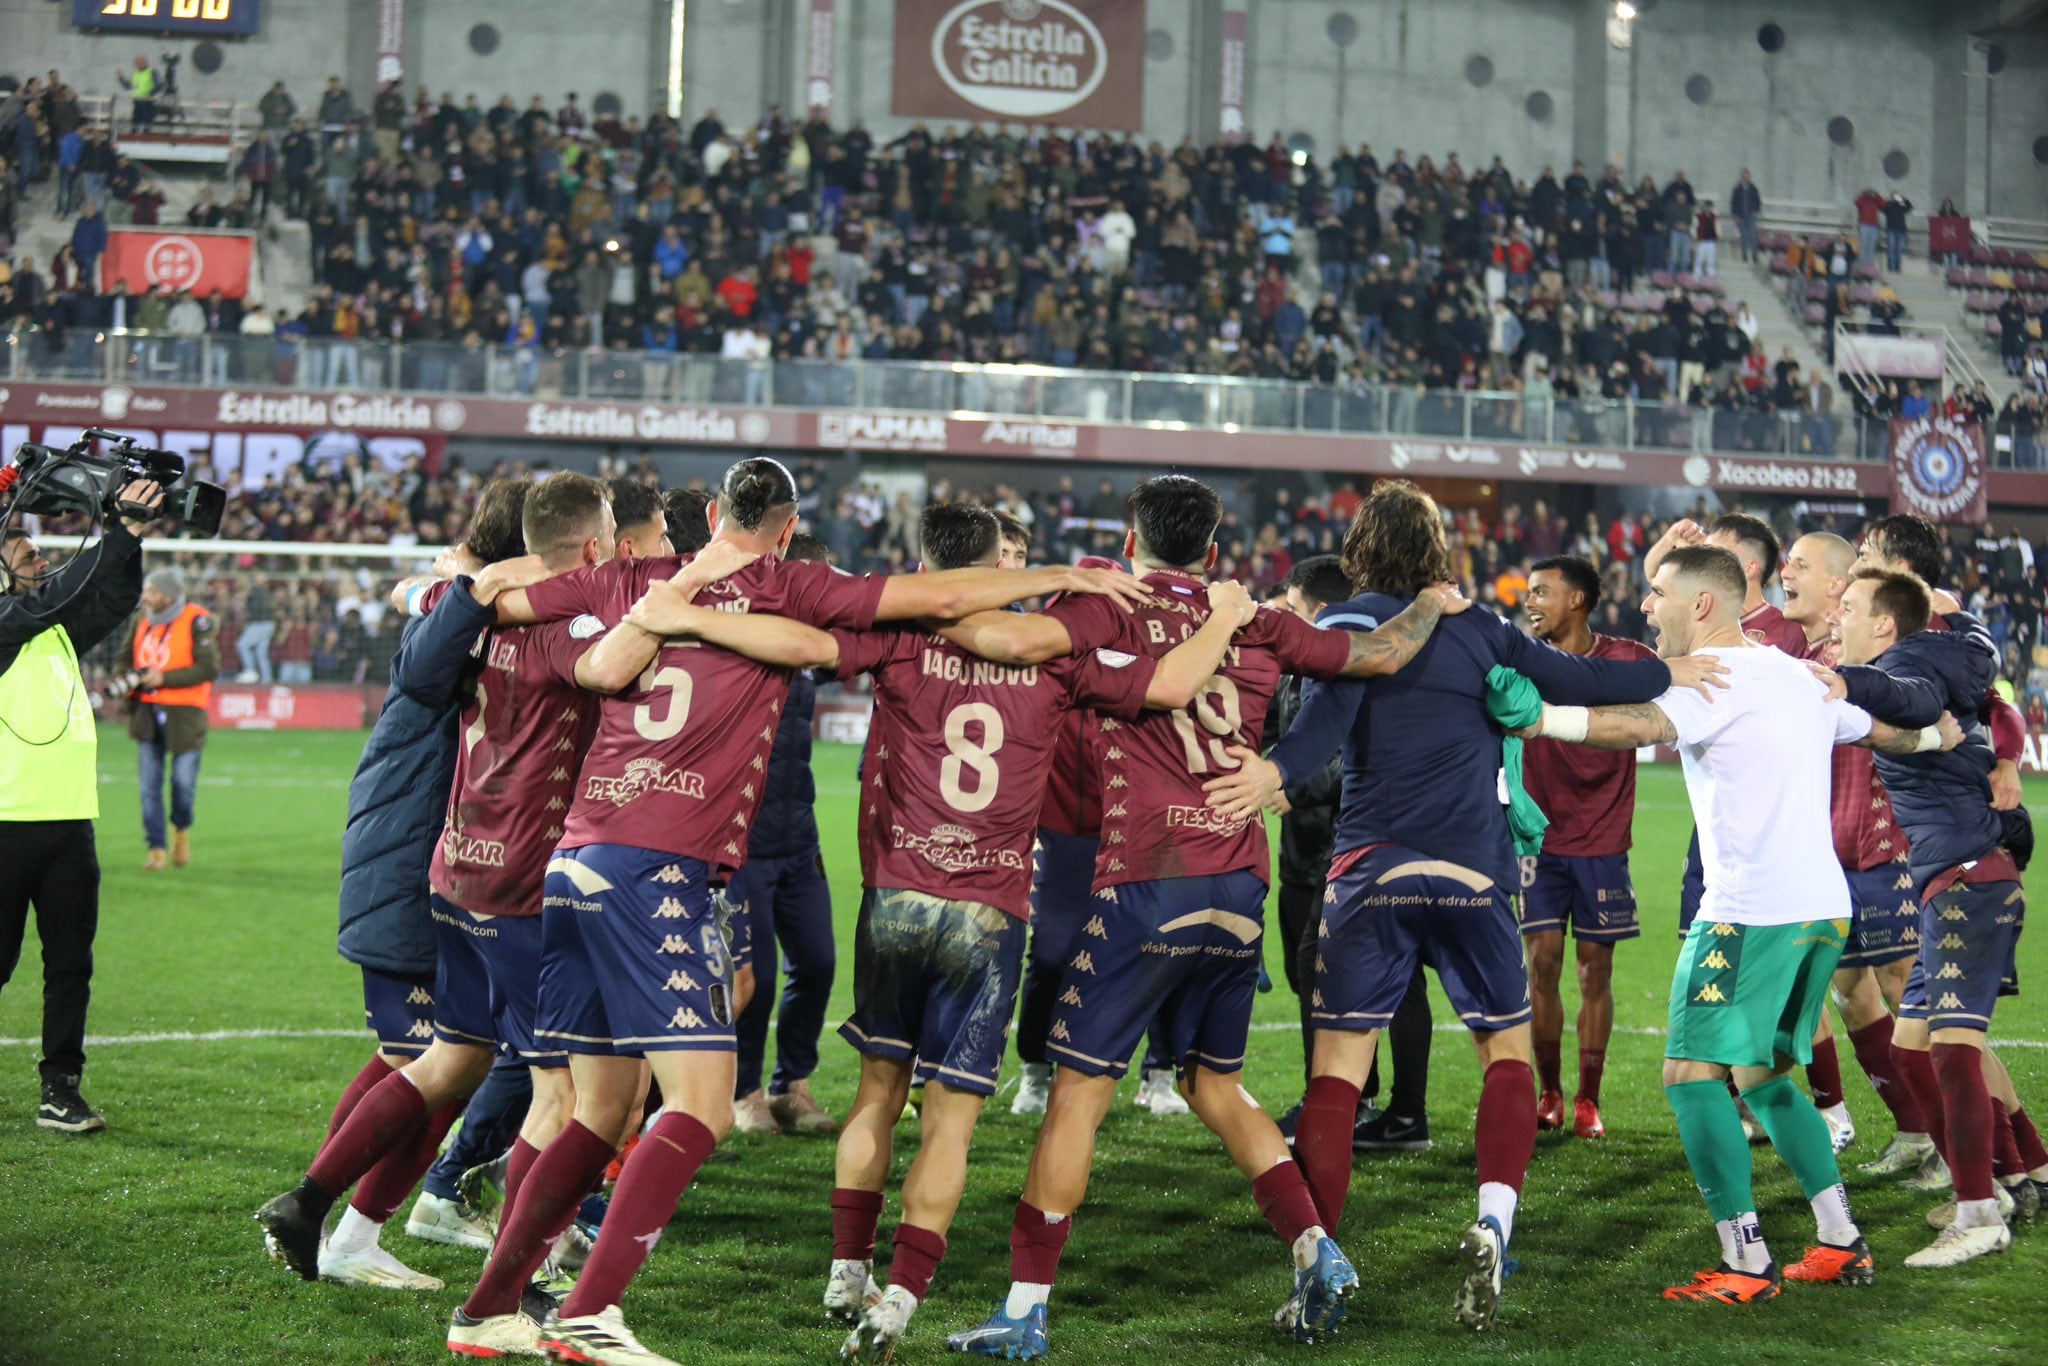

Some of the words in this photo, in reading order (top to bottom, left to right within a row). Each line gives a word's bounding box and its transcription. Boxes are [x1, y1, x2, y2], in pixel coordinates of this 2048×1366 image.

[958, 15, 1085, 55] Estrella
[962, 50, 1078, 88] Galicia
[217, 391, 328, 425] Estrella
[330, 394, 431, 429] Galicia
[526, 402, 634, 437] Estrella
[637, 406, 736, 441] Galicia
[923, 648, 969, 686] IAGO
[973, 662, 1038, 686] NOVO
[633, 641, 693, 741] 5
[939, 702, 1004, 813] 8
[701, 925, 724, 977] 5
